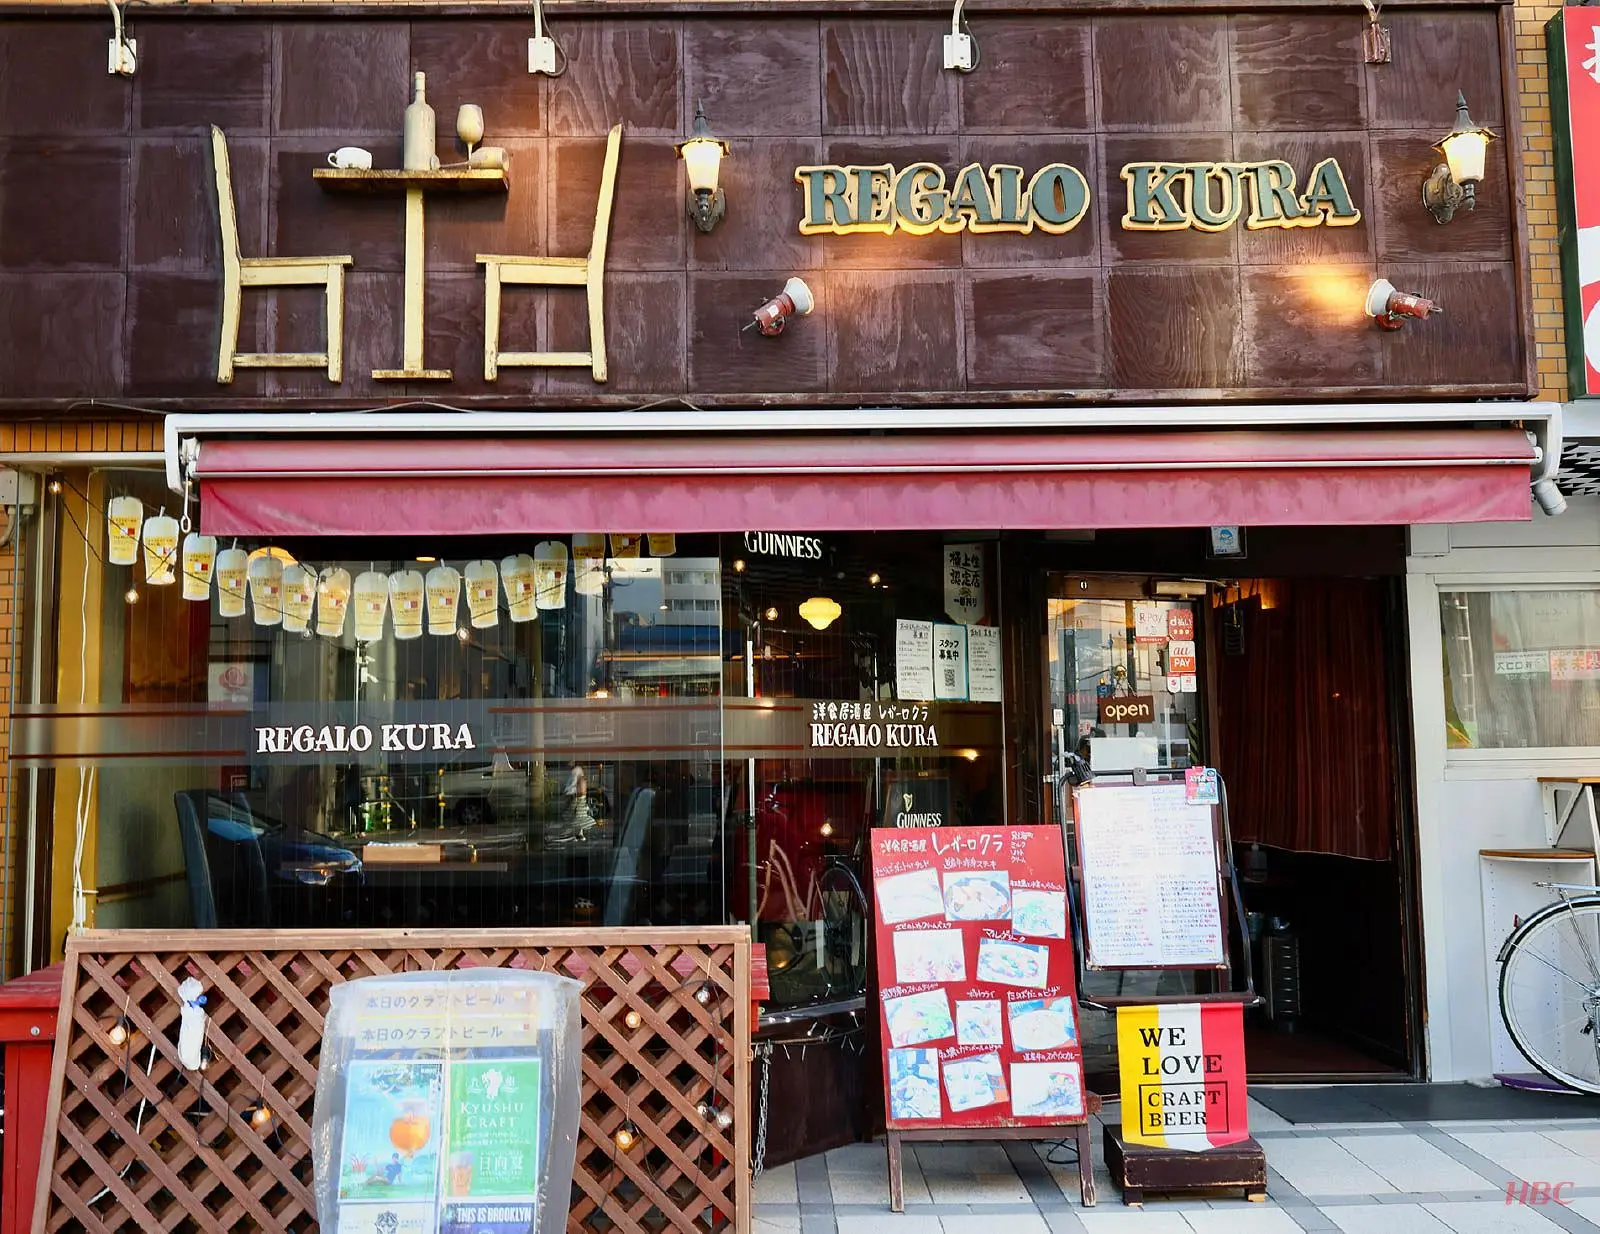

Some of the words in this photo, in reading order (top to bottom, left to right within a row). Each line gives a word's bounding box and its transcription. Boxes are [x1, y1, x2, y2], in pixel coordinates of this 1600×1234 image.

[797, 162, 1090, 234] REGALO
[1122, 158, 1361, 230] KURA
[744, 531, 823, 559] GUINNESS
[939, 639, 959, 648] スタッフ
[1173, 647, 1190, 656] au
[939, 650, 959, 660] 募集中
[1174, 658, 1190, 668] PAY
[813, 702, 871, 720] 洋食居酒屋
[1105, 703, 1149, 721] open
[255, 725, 372, 753] REGALO
[381, 723, 475, 750] KURA
[810, 723, 881, 747] REGALO
[886, 724, 938, 747] KURA
[897, 812, 941, 828] GUINNESS
[361, 1024, 503, 1041] 本日のクラフトビール
[1139, 1027, 1186, 1047] WE
[1142, 1055, 1222, 1075] LOVE
[1148, 1090, 1220, 1106] CRAFT
[461, 1102, 524, 1114] KYUSHU
[466, 1116, 517, 1128] CRAFT
[1149, 1111, 1207, 1127] BEER
[457, 1207, 477, 1224] THIS
[478, 1207, 487, 1224] IS
[488, 1207, 532, 1224] BROOKLYN
